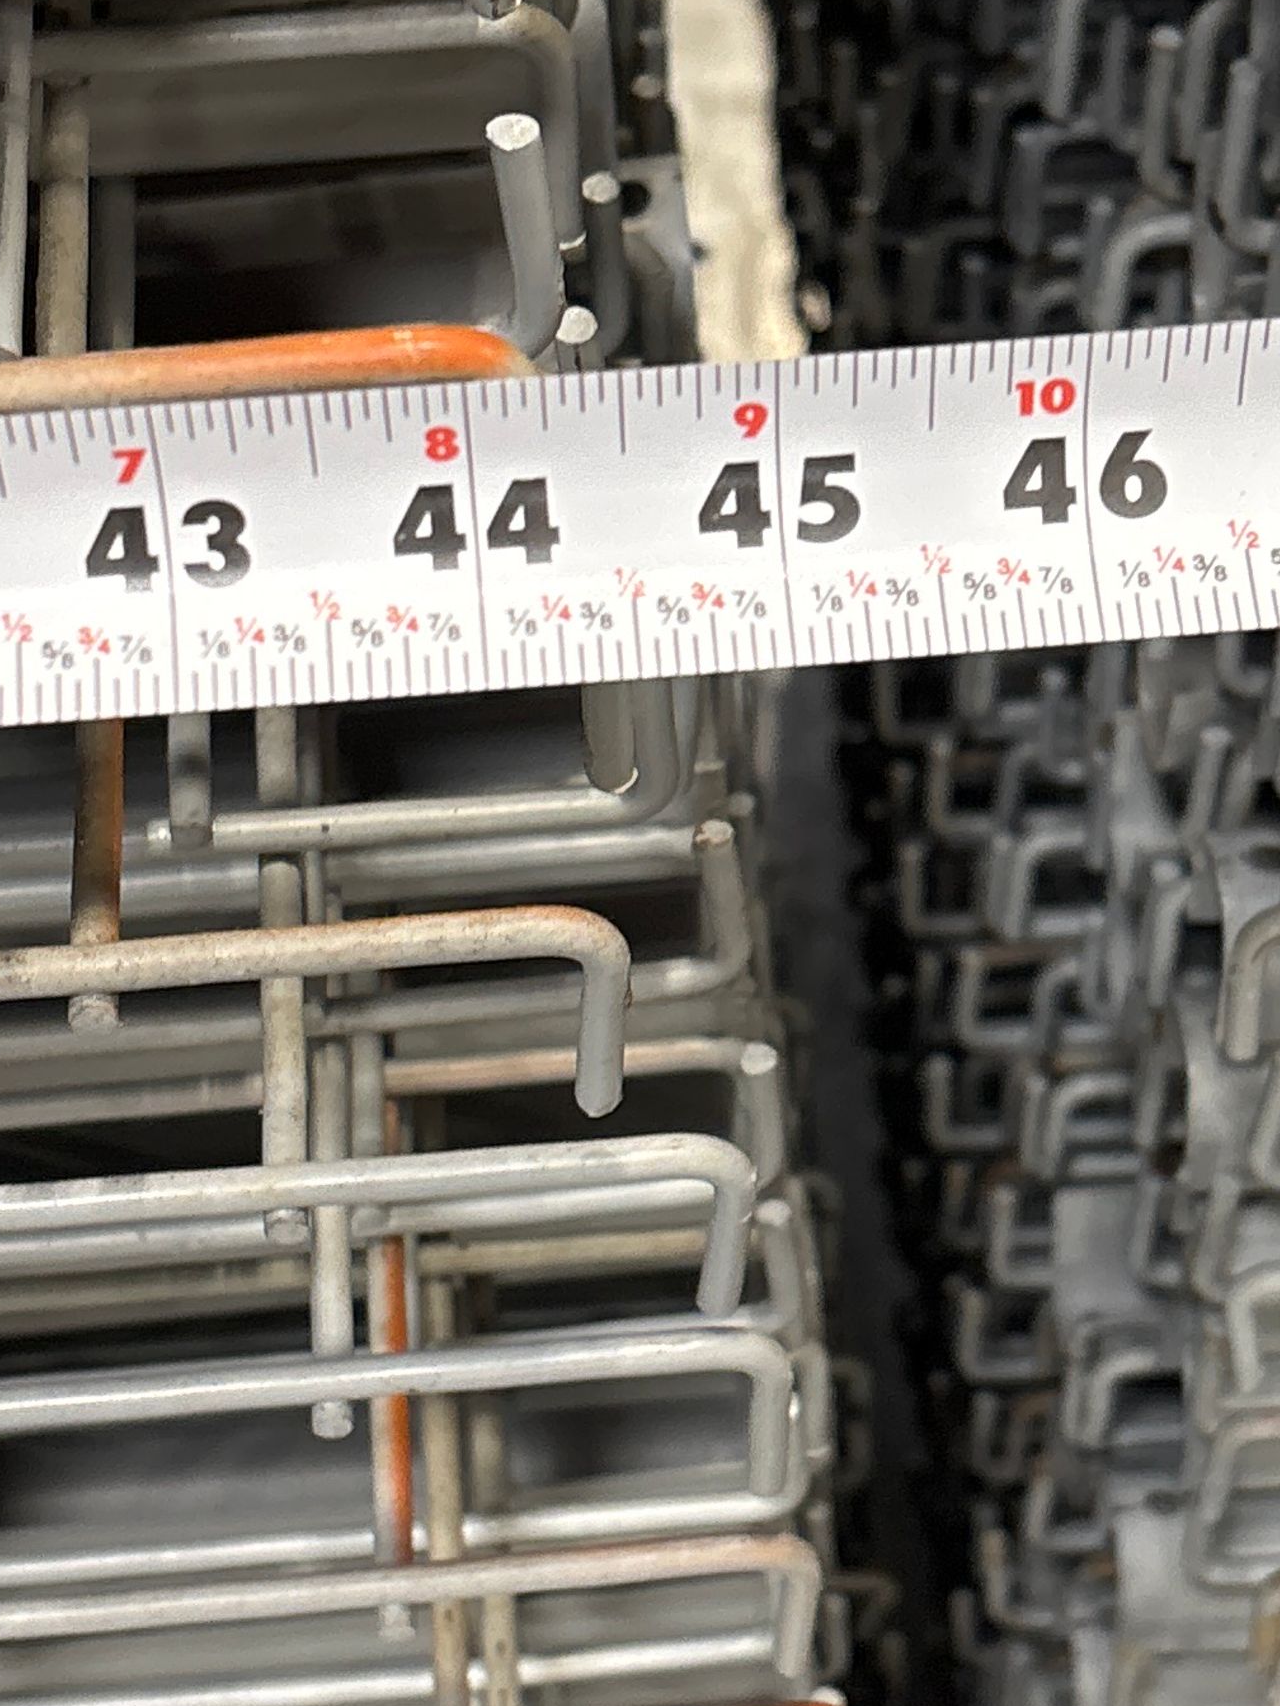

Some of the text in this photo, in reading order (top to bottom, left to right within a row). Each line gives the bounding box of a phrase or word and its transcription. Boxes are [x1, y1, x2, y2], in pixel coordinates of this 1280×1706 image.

[112, 447, 147, 485] 7
[424, 425, 460, 462] 8
[733, 401, 769, 439] 9
[1014, 377, 1077, 417] 10
[85, 499, 253, 593] 43
[393, 477, 561, 571] 44
[697, 453, 862, 548] 45
[1003, 429, 1169, 525] 46
[1, 612, 33, 643] 1/2
[77, 625, 112, 657] 3/4
[234, 615, 265, 644] 1/4
[309, 590, 342, 621] 1/2
[386, 603, 419, 634] 3/4
[540, 594, 572, 623] 1/4
[613, 567, 646, 598] 1/2
[690, 582, 725, 612] 3/4
[846, 569, 877, 599] 1/4
[919, 544, 952, 575] 1/2
[963, 571, 997, 603] 5/8
[997, 557, 1032, 587] 3/4
[1038, 565, 1073, 595] 7/8
[1120, 560, 1151, 589] 1/8
[1152, 545, 1184, 574] 1/4
[1192, 552, 1228, 583] 3/8
[1226, 519, 1260, 550] 1/2
